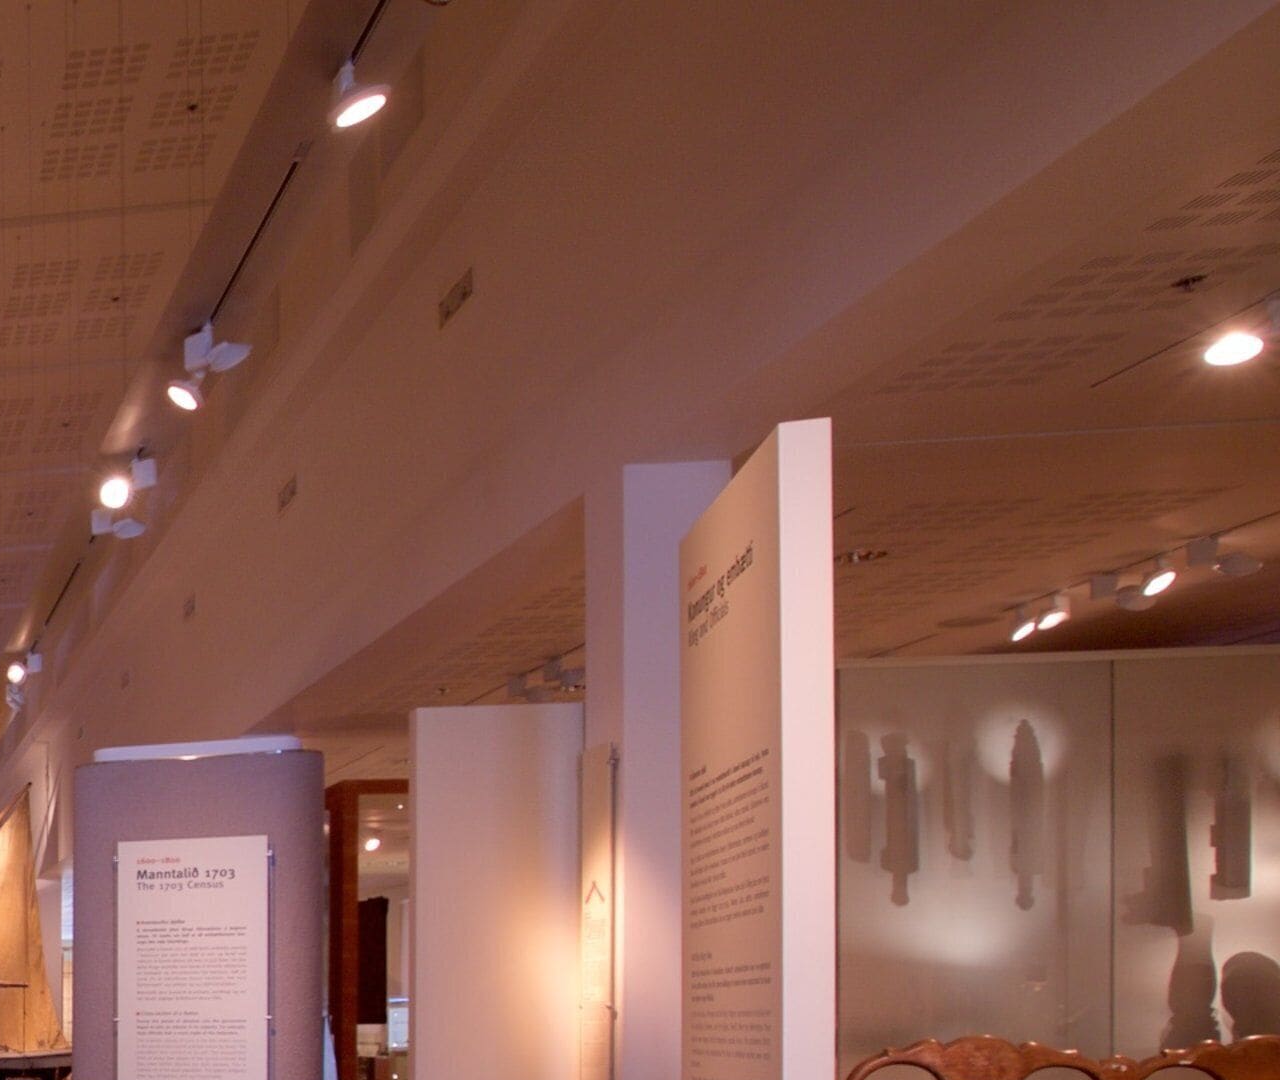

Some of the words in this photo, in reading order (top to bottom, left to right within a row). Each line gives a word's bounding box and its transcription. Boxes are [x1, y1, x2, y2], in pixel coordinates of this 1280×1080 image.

[137, 867, 199, 880] Manntalið
[205, 868, 236, 880] 1703
[137, 882, 155, 891] The
[159, 882, 184, 892] 1703
[187, 880, 224, 889] Census
